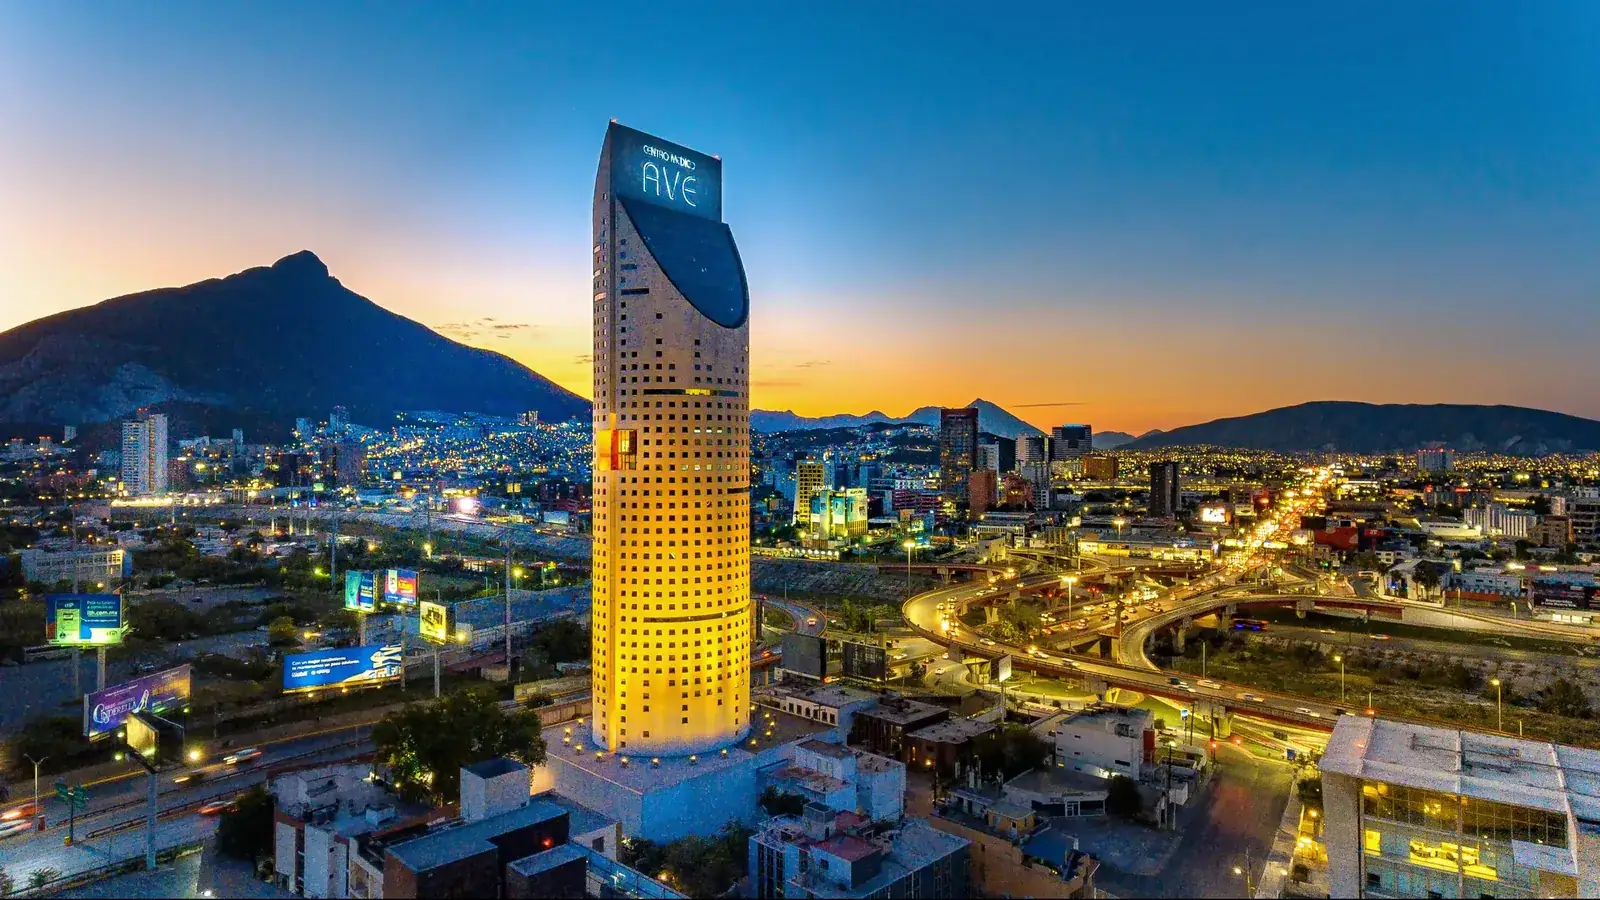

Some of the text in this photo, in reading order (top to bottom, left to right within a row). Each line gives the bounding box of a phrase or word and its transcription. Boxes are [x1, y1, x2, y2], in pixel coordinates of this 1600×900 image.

[643, 144, 670, 161] CENTRO
[643, 161, 697, 207] AVE
[93, 701, 138, 724] CINDERELLA
